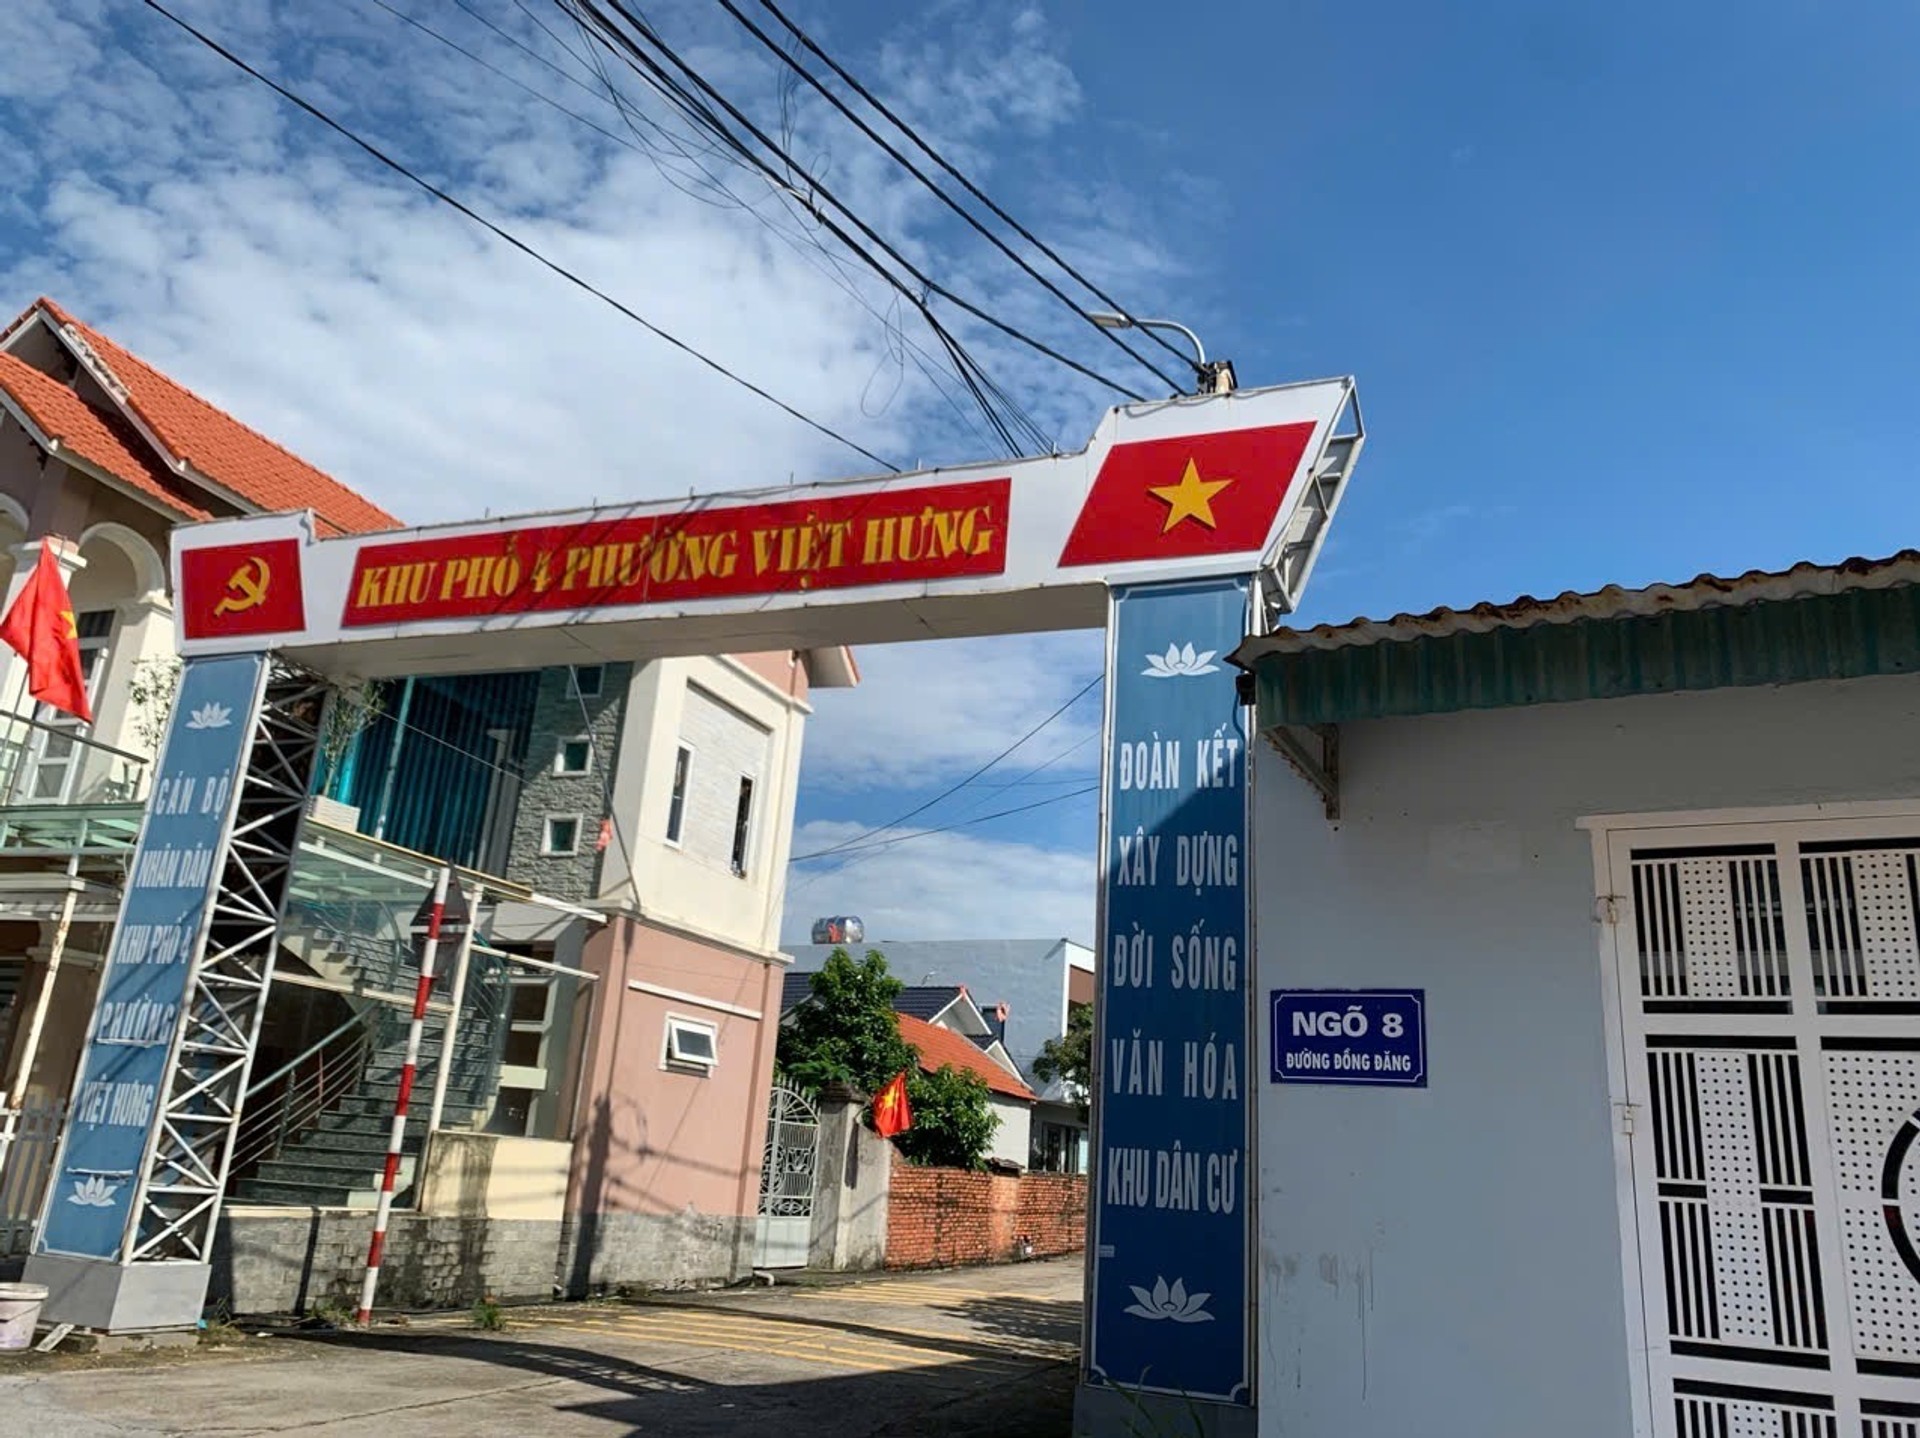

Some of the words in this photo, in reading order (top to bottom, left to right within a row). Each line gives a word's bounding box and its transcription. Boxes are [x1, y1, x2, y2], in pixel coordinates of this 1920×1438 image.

[356, 561, 438, 608] KHU
[440, 534, 520, 600] PHỐ
[532, 548, 550, 593] 4
[561, 527, 738, 591] PHƯỜNG
[753, 512, 852, 589] VIỆT
[863, 505, 991, 565] HƯNG
[1119, 732, 1180, 790] ĐOÀN
[1196, 722, 1238, 788] KẾT
[155, 770, 196, 815] CÁN
[201, 768, 230, 820] BỘ
[135, 843, 179, 888] NHÂN
[177, 842, 213, 887] DÂN
[1117, 826, 1161, 886] XÂY
[1176, 831, 1238, 896] DỰNG
[116, 925, 150, 964] KHU
[147, 911, 183, 965] PHỐ
[180, 927, 193, 964] 4
[1113, 921, 1154, 988] ĐỜI
[1171, 919, 1237, 991] SỐNG
[100, 993, 176, 1044] PHƯỜNG
[1292, 1005, 1368, 1037] NGÕ
[1382, 1013, 1404, 1038] 8
[1111, 1028, 1164, 1096] VĂN
[1183, 1032, 1237, 1100] HÓA
[1286, 1048, 1330, 1070] ĐƯỜNG
[1374, 1051, 1412, 1072] ĐĂNG
[78, 1073, 113, 1131] VIỆT
[108, 1079, 155, 1127] HƯNG
[1107, 1147, 1150, 1207] KHU
[1155, 1140, 1199, 1211] DÂN
[1206, 1149, 1238, 1214] CƯ
